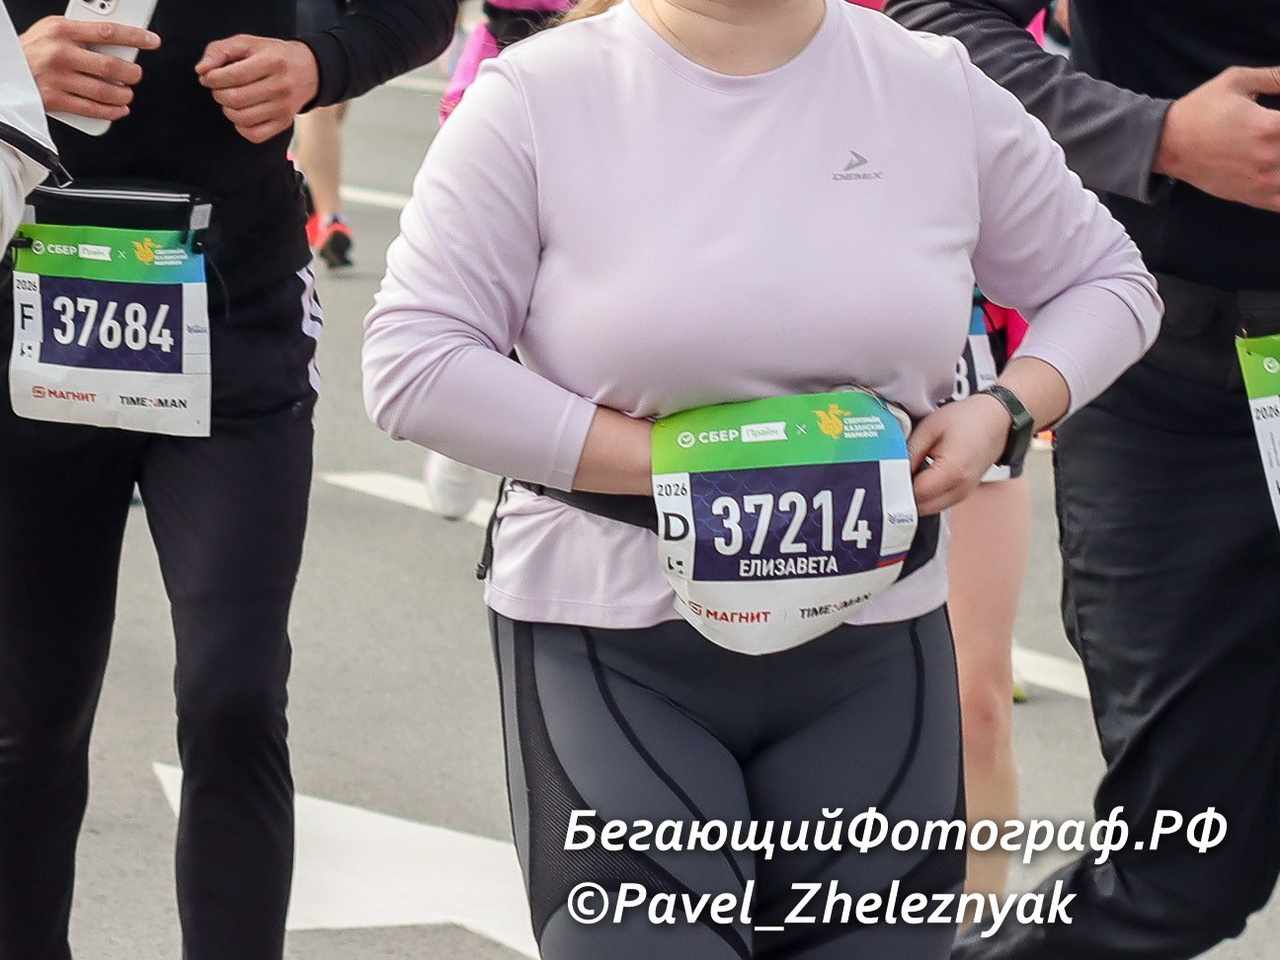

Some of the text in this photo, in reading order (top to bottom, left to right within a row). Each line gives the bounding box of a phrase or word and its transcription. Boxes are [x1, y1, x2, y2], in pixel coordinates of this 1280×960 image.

[47, 244, 78, 257] СБЕР
[20, 302, 35, 331] F
[52, 295, 175, 354] 37684
[47, 388, 97, 402] МАГНИТ
[697, 430, 739, 444] СБЕР
[657, 483, 688, 497] 2026
[662, 511, 690, 542] D
[711, 487, 872, 556] 37214
[738, 555, 839, 578] ЕЛИЗАВЕТА
[705, 609, 771, 624] МАГНИТ
